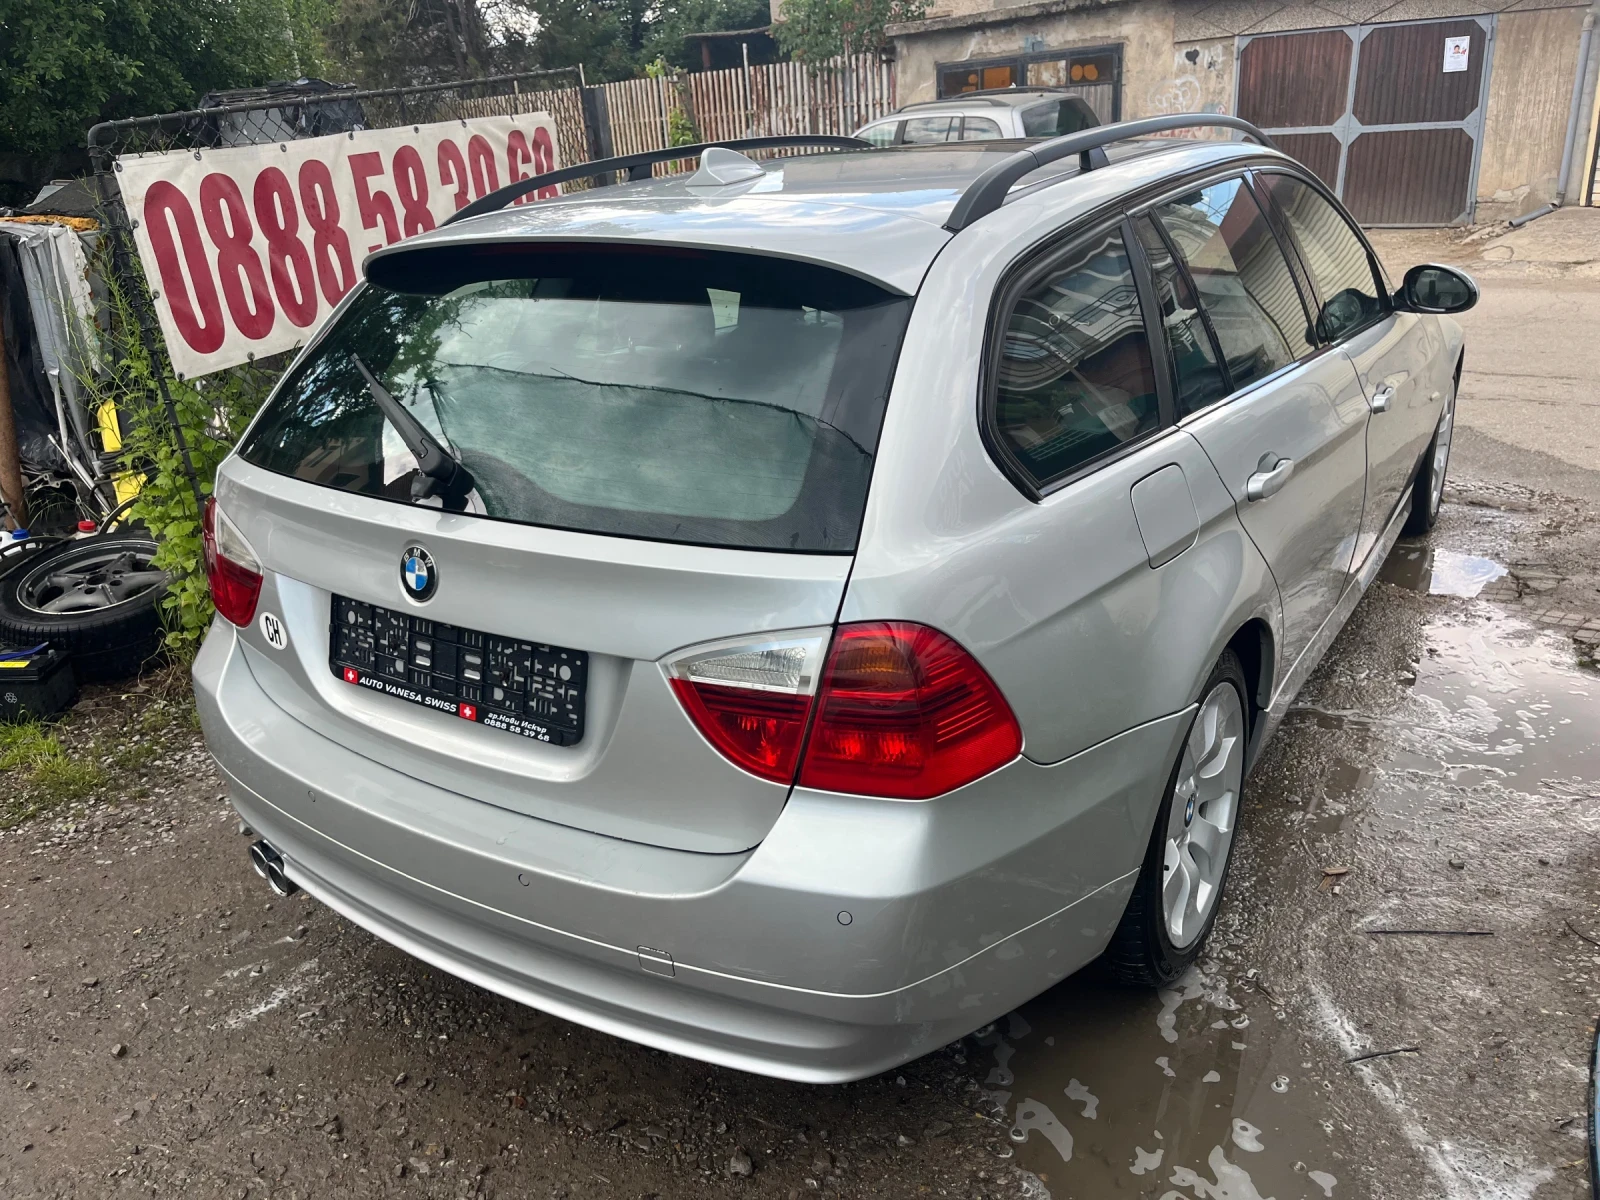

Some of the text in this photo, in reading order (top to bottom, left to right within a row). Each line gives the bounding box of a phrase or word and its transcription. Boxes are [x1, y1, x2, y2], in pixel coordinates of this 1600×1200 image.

[144, 159, 357, 354] 0888
[347, 145, 436, 254] 58
[403, 547, 433, 568] BMW
[265, 615, 283, 647] CH
[359, 676, 457, 713] AUTO VANESA SWISS
[484, 718, 550, 742] 0888 58 39 68
